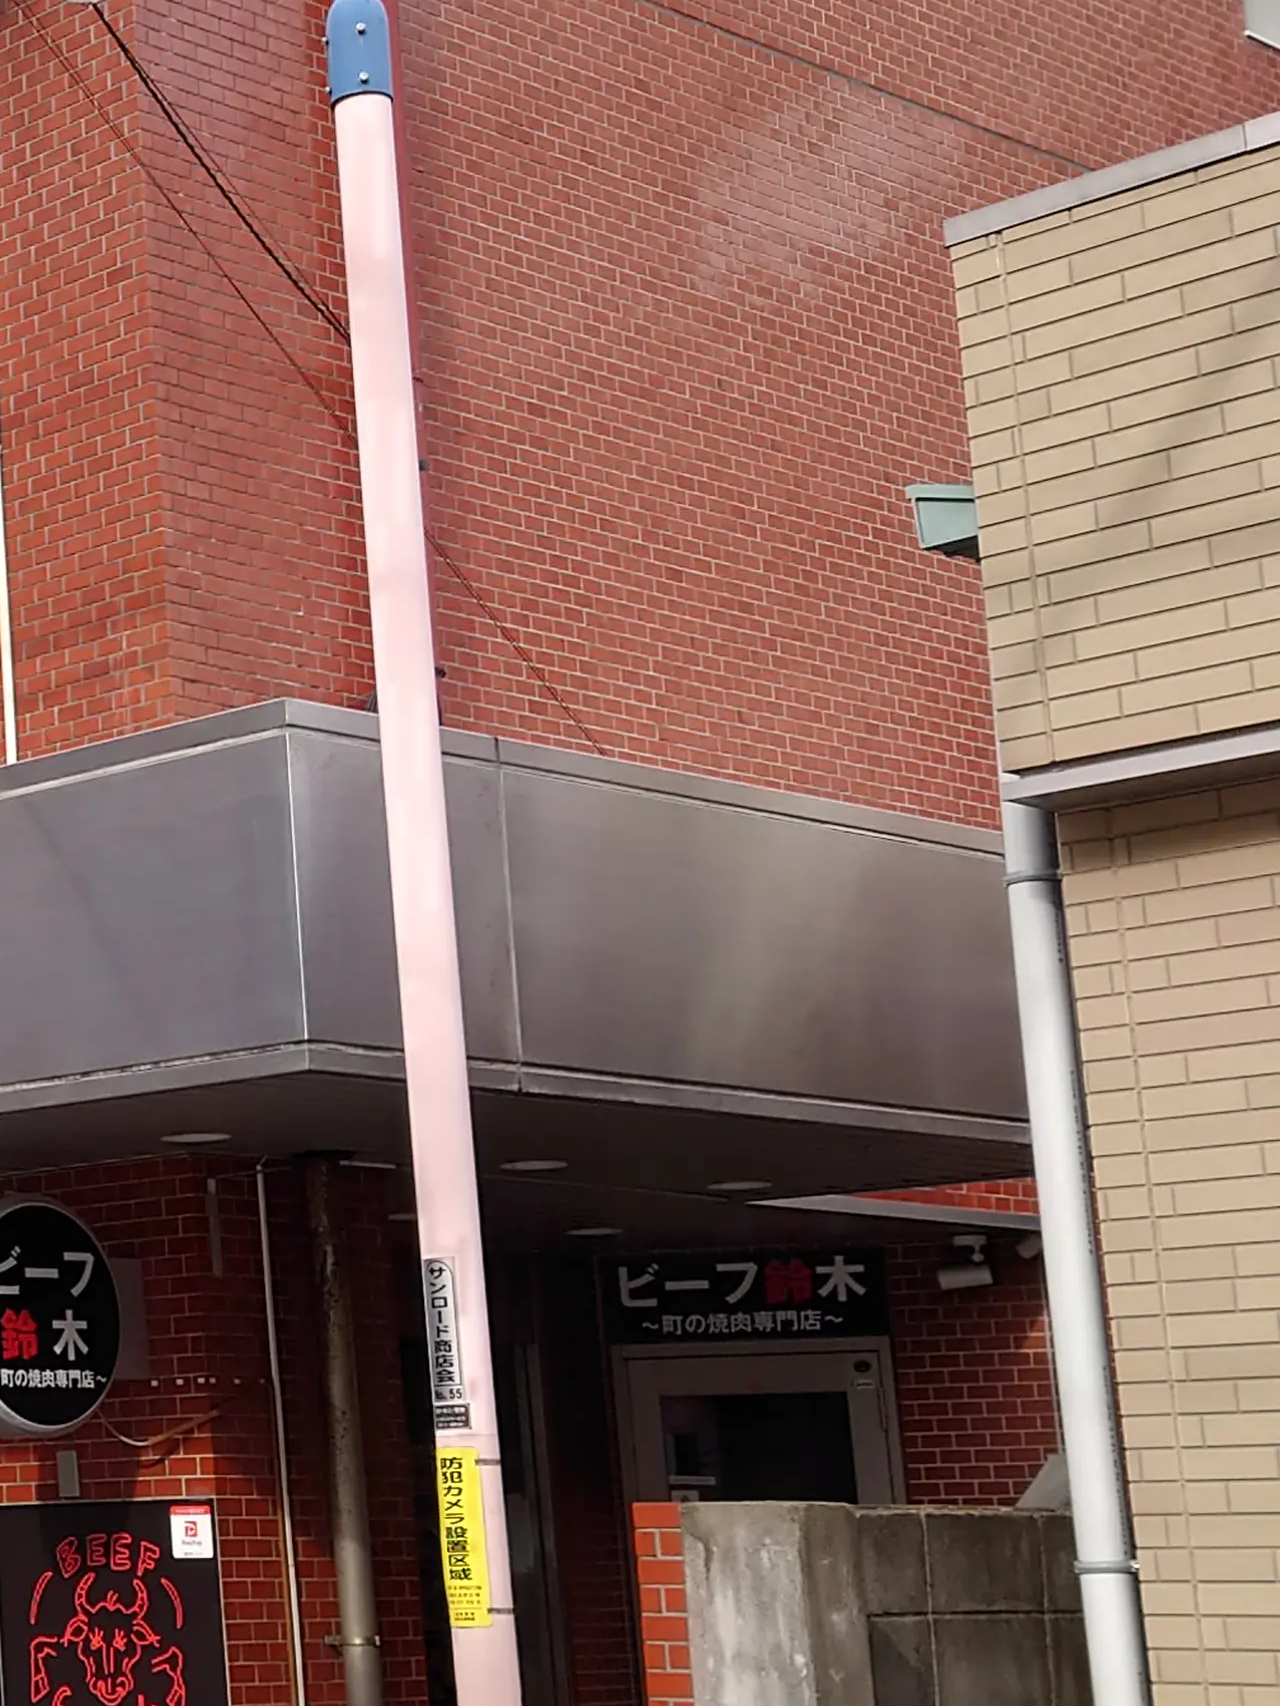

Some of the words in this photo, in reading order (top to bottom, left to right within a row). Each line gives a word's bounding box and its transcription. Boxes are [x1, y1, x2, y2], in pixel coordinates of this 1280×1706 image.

[617, 1255, 867, 1308] ビーフ鈴木
[0, 1308, 89, 1361] 鈴木
[429, 1266, 456, 1383] サンロード商店会
[440, 1456, 473, 1581] 防犯カメラ設置区域
[56, 1532, 160, 1578] BEEF
